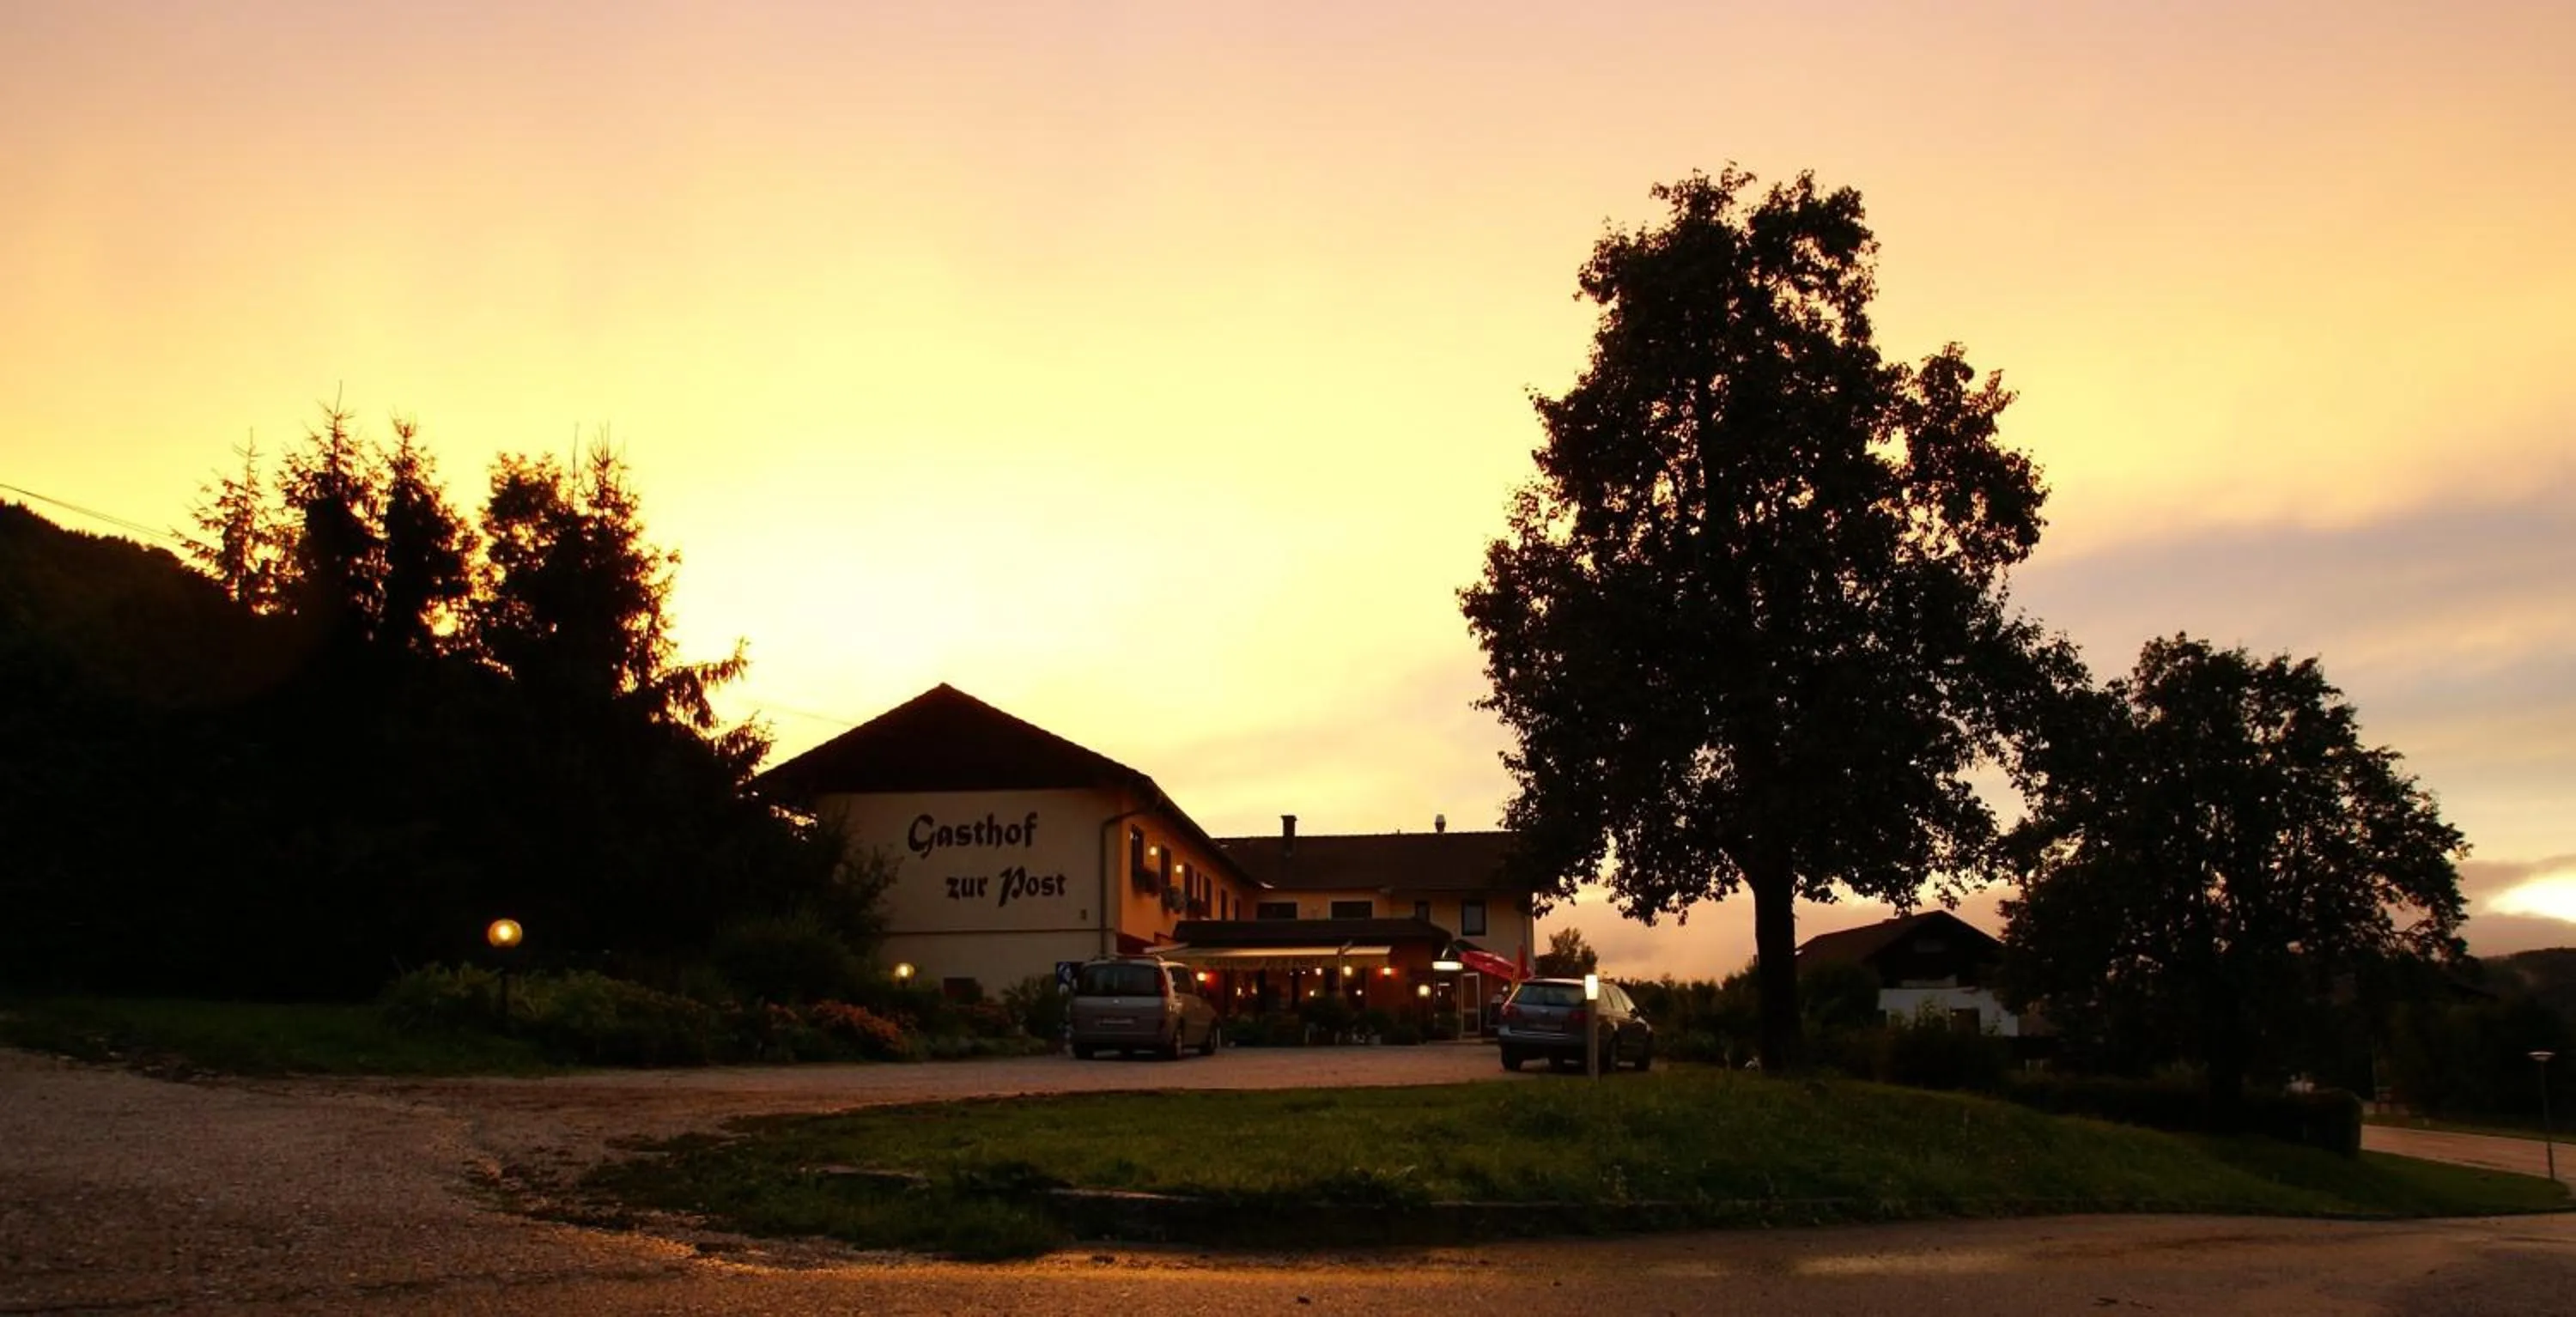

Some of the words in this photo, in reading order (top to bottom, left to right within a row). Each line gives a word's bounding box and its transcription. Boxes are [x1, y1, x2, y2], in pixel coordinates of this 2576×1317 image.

[908, 811, 1037, 859] Gasthof
[945, 876, 988, 901] zur
[999, 865, 1066, 907] Post
